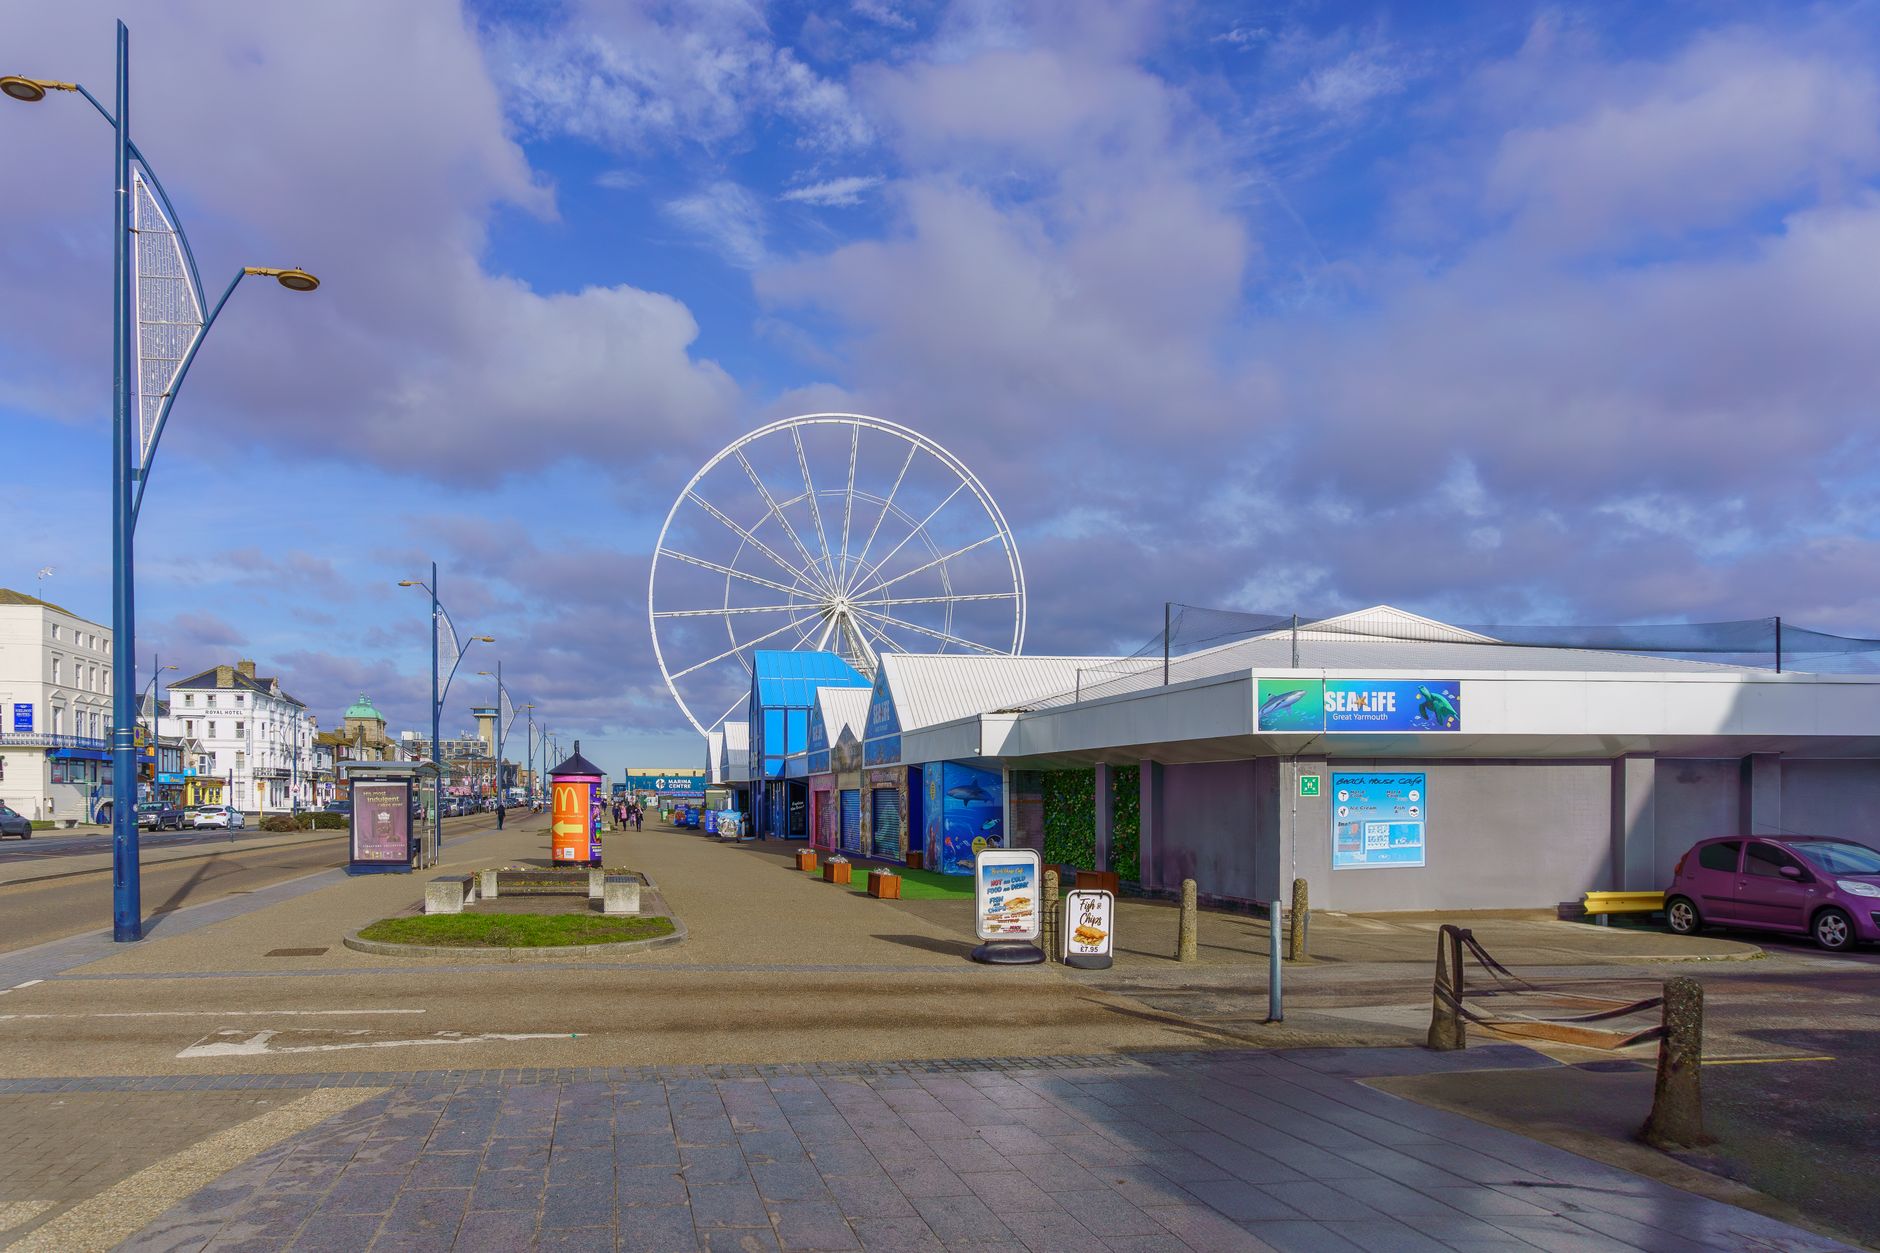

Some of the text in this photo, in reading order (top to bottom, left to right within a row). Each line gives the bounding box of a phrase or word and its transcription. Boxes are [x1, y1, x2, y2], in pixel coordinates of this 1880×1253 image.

[1332, 713, 1388, 721] Great Yarmouth
[367, 796, 400, 804] indulgent
[990, 879, 1002, 887] HOT
[986, 886, 1002, 894] FOOD
[1011, 882, 1029, 890] DRINK
[989, 896, 1004, 904] FISH
[1080, 898, 1095, 912] Fish
[1080, 912, 1102, 927] Chips
